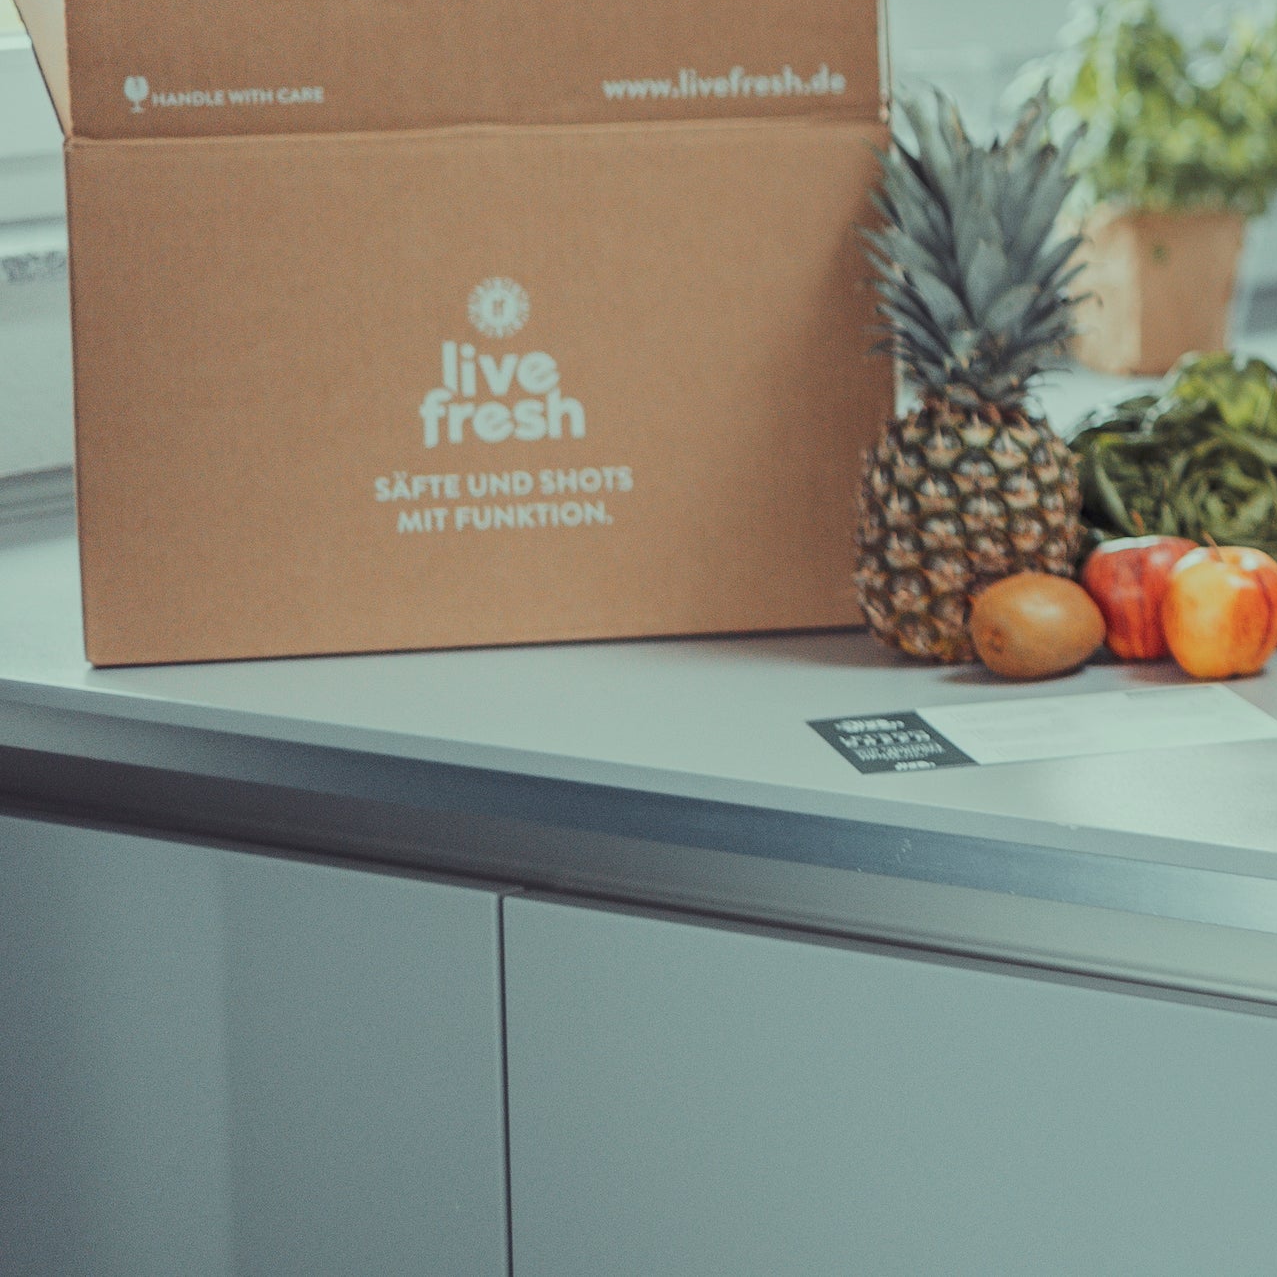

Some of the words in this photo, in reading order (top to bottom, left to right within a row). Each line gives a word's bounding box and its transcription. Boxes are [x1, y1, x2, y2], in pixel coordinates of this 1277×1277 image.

[152, 90, 225, 107] HANDLE
[228, 88, 274, 105] WITH
[276, 86, 325, 104] CARE
[602, 62, 847, 100] www.livefresh.de
[441, 340, 561, 398] live
[418, 385, 587, 450] fresh
[374, 471, 461, 503] SÄFTE
[467, 470, 535, 498] UND
[539, 465, 635, 496] SHOTS
[396, 508, 449, 535] MIT
[454, 500, 614, 532] FUNKTION.
